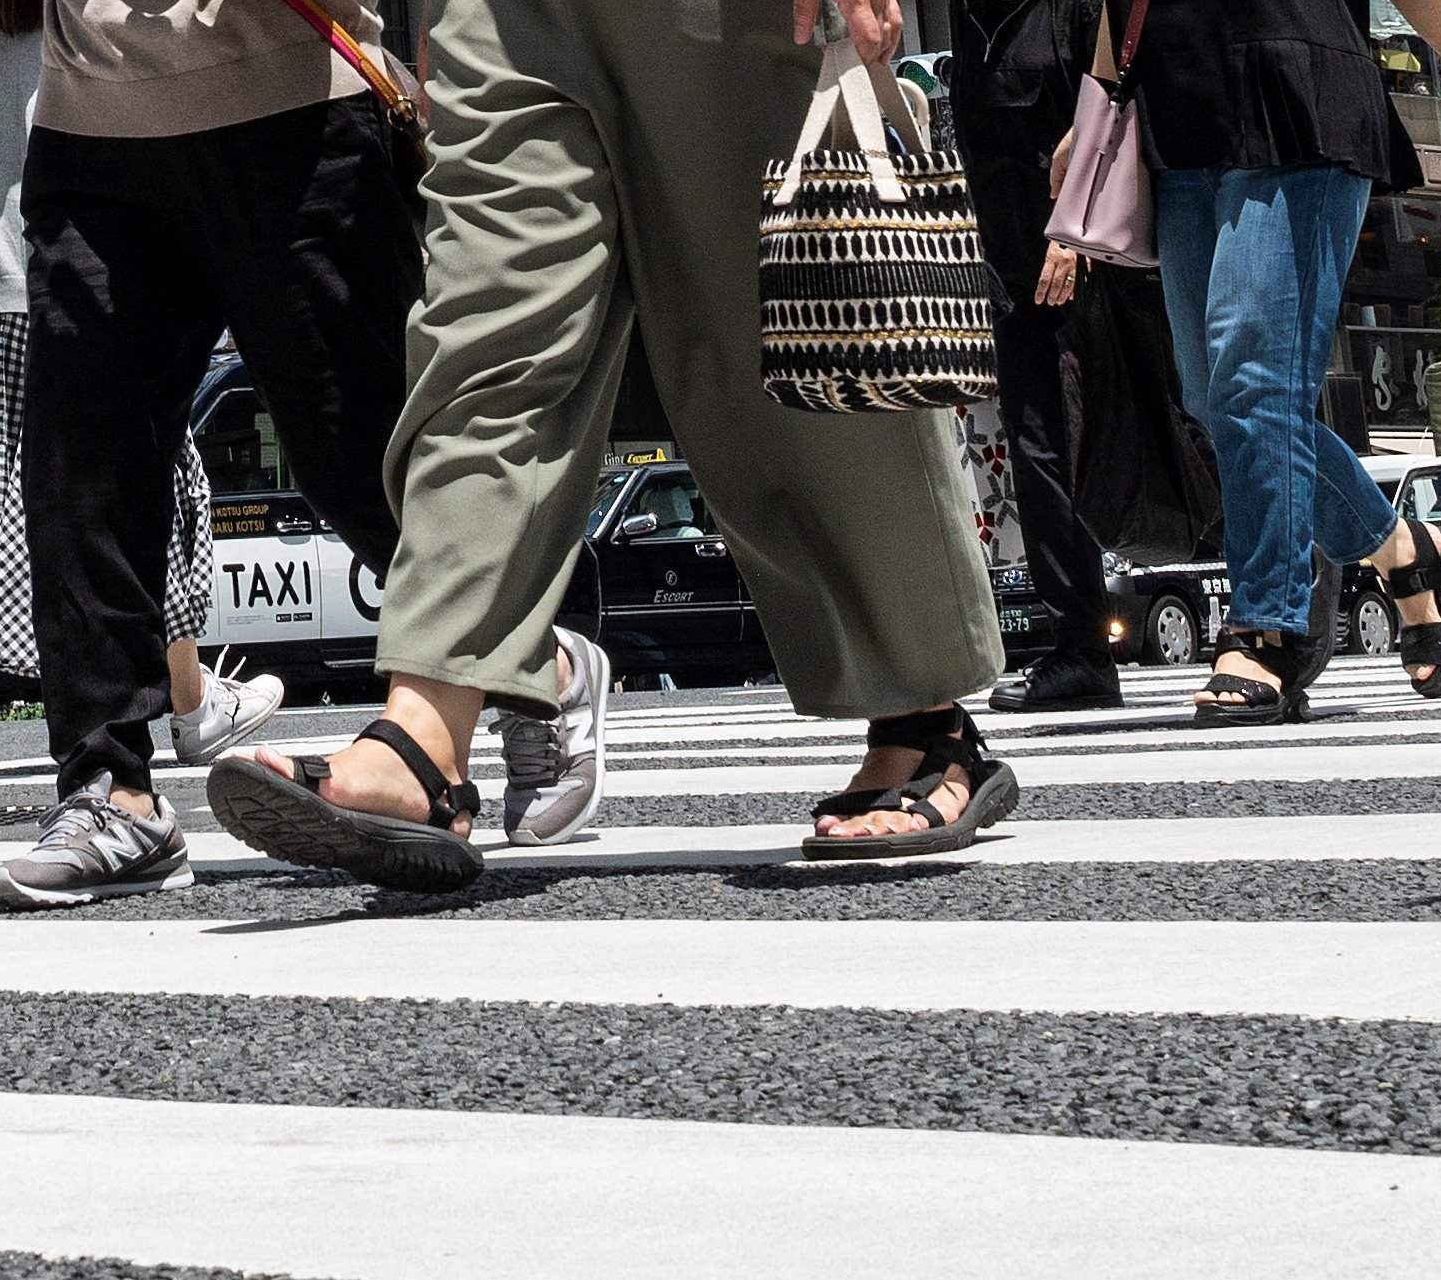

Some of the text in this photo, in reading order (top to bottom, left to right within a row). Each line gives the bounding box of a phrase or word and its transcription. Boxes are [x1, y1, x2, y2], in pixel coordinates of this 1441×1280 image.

[217, 506, 241, 518] KOTSU
[242, 504, 269, 516] GROUP
[235, 521, 265, 533] KOTSU
[222, 560, 312, 609] TAXI
